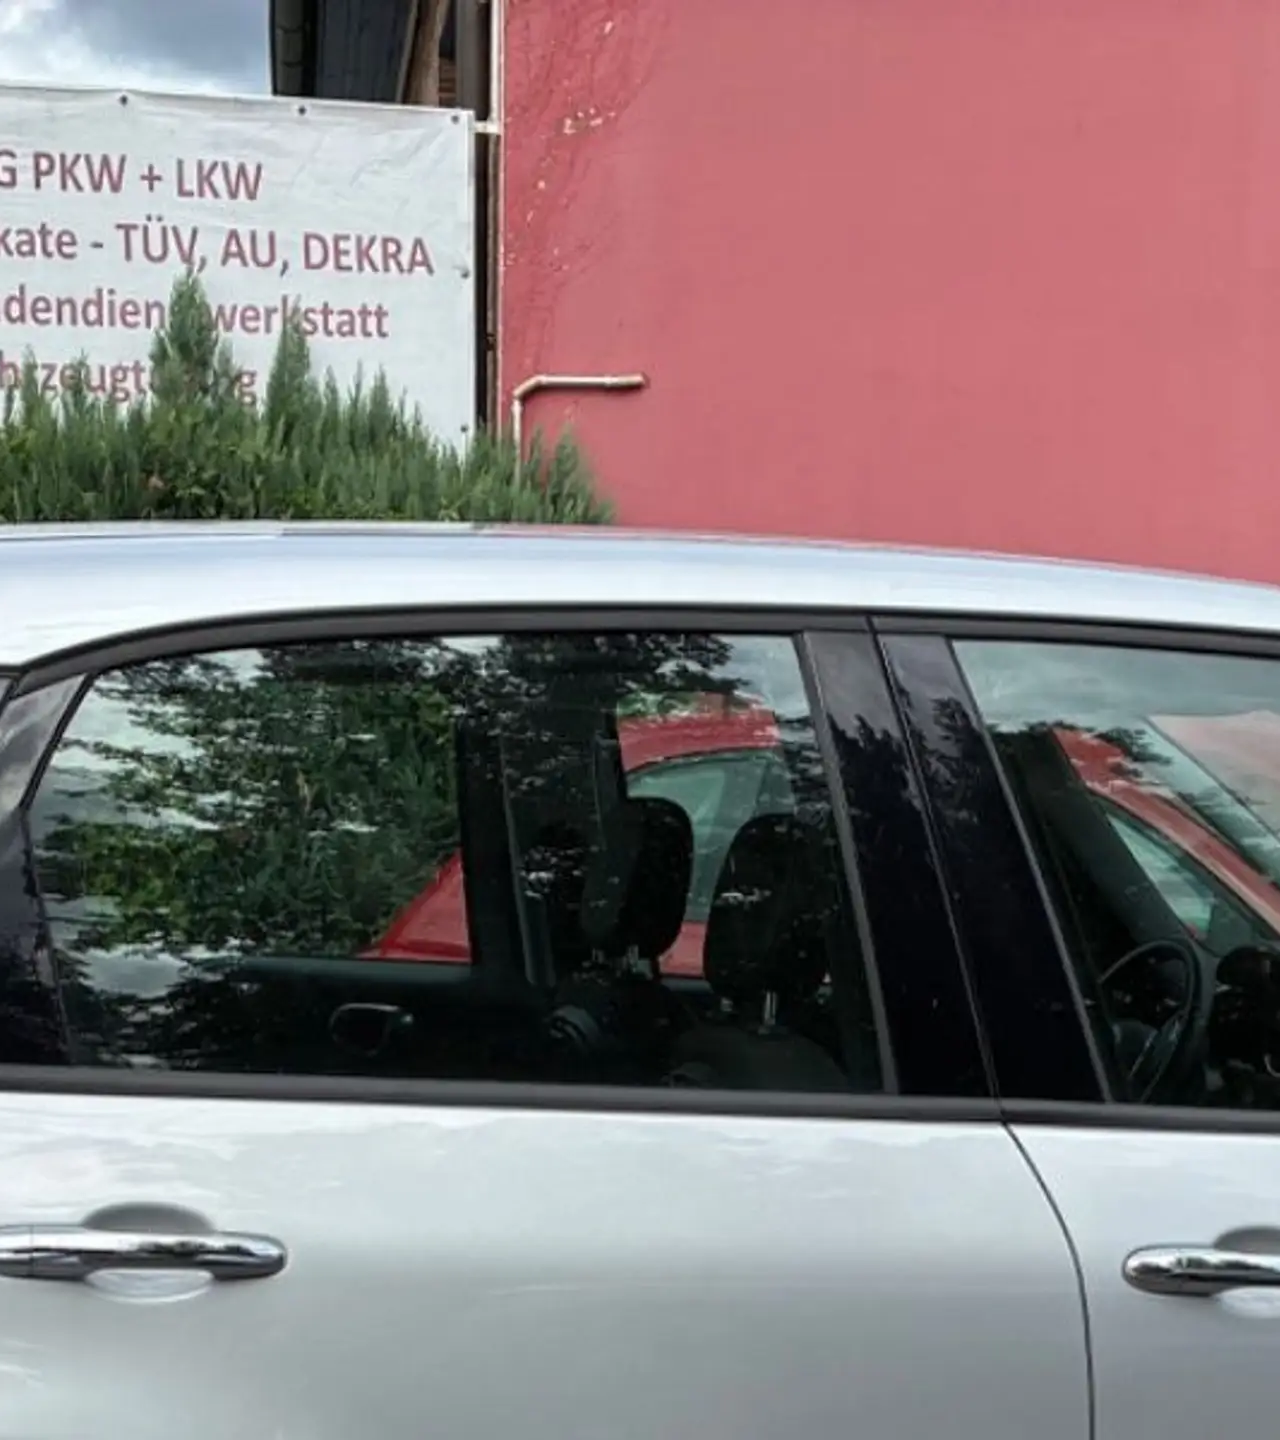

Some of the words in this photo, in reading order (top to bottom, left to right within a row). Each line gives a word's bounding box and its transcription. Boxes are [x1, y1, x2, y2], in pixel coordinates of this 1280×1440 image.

[34, 151, 128, 194] PKW
[139, 168, 164, 193] +
[176, 157, 264, 201] LKW
[116, 214, 207, 273] TÜV,
[221, 228, 289, 276] AU,
[304, 231, 435, 276] DEKRA
